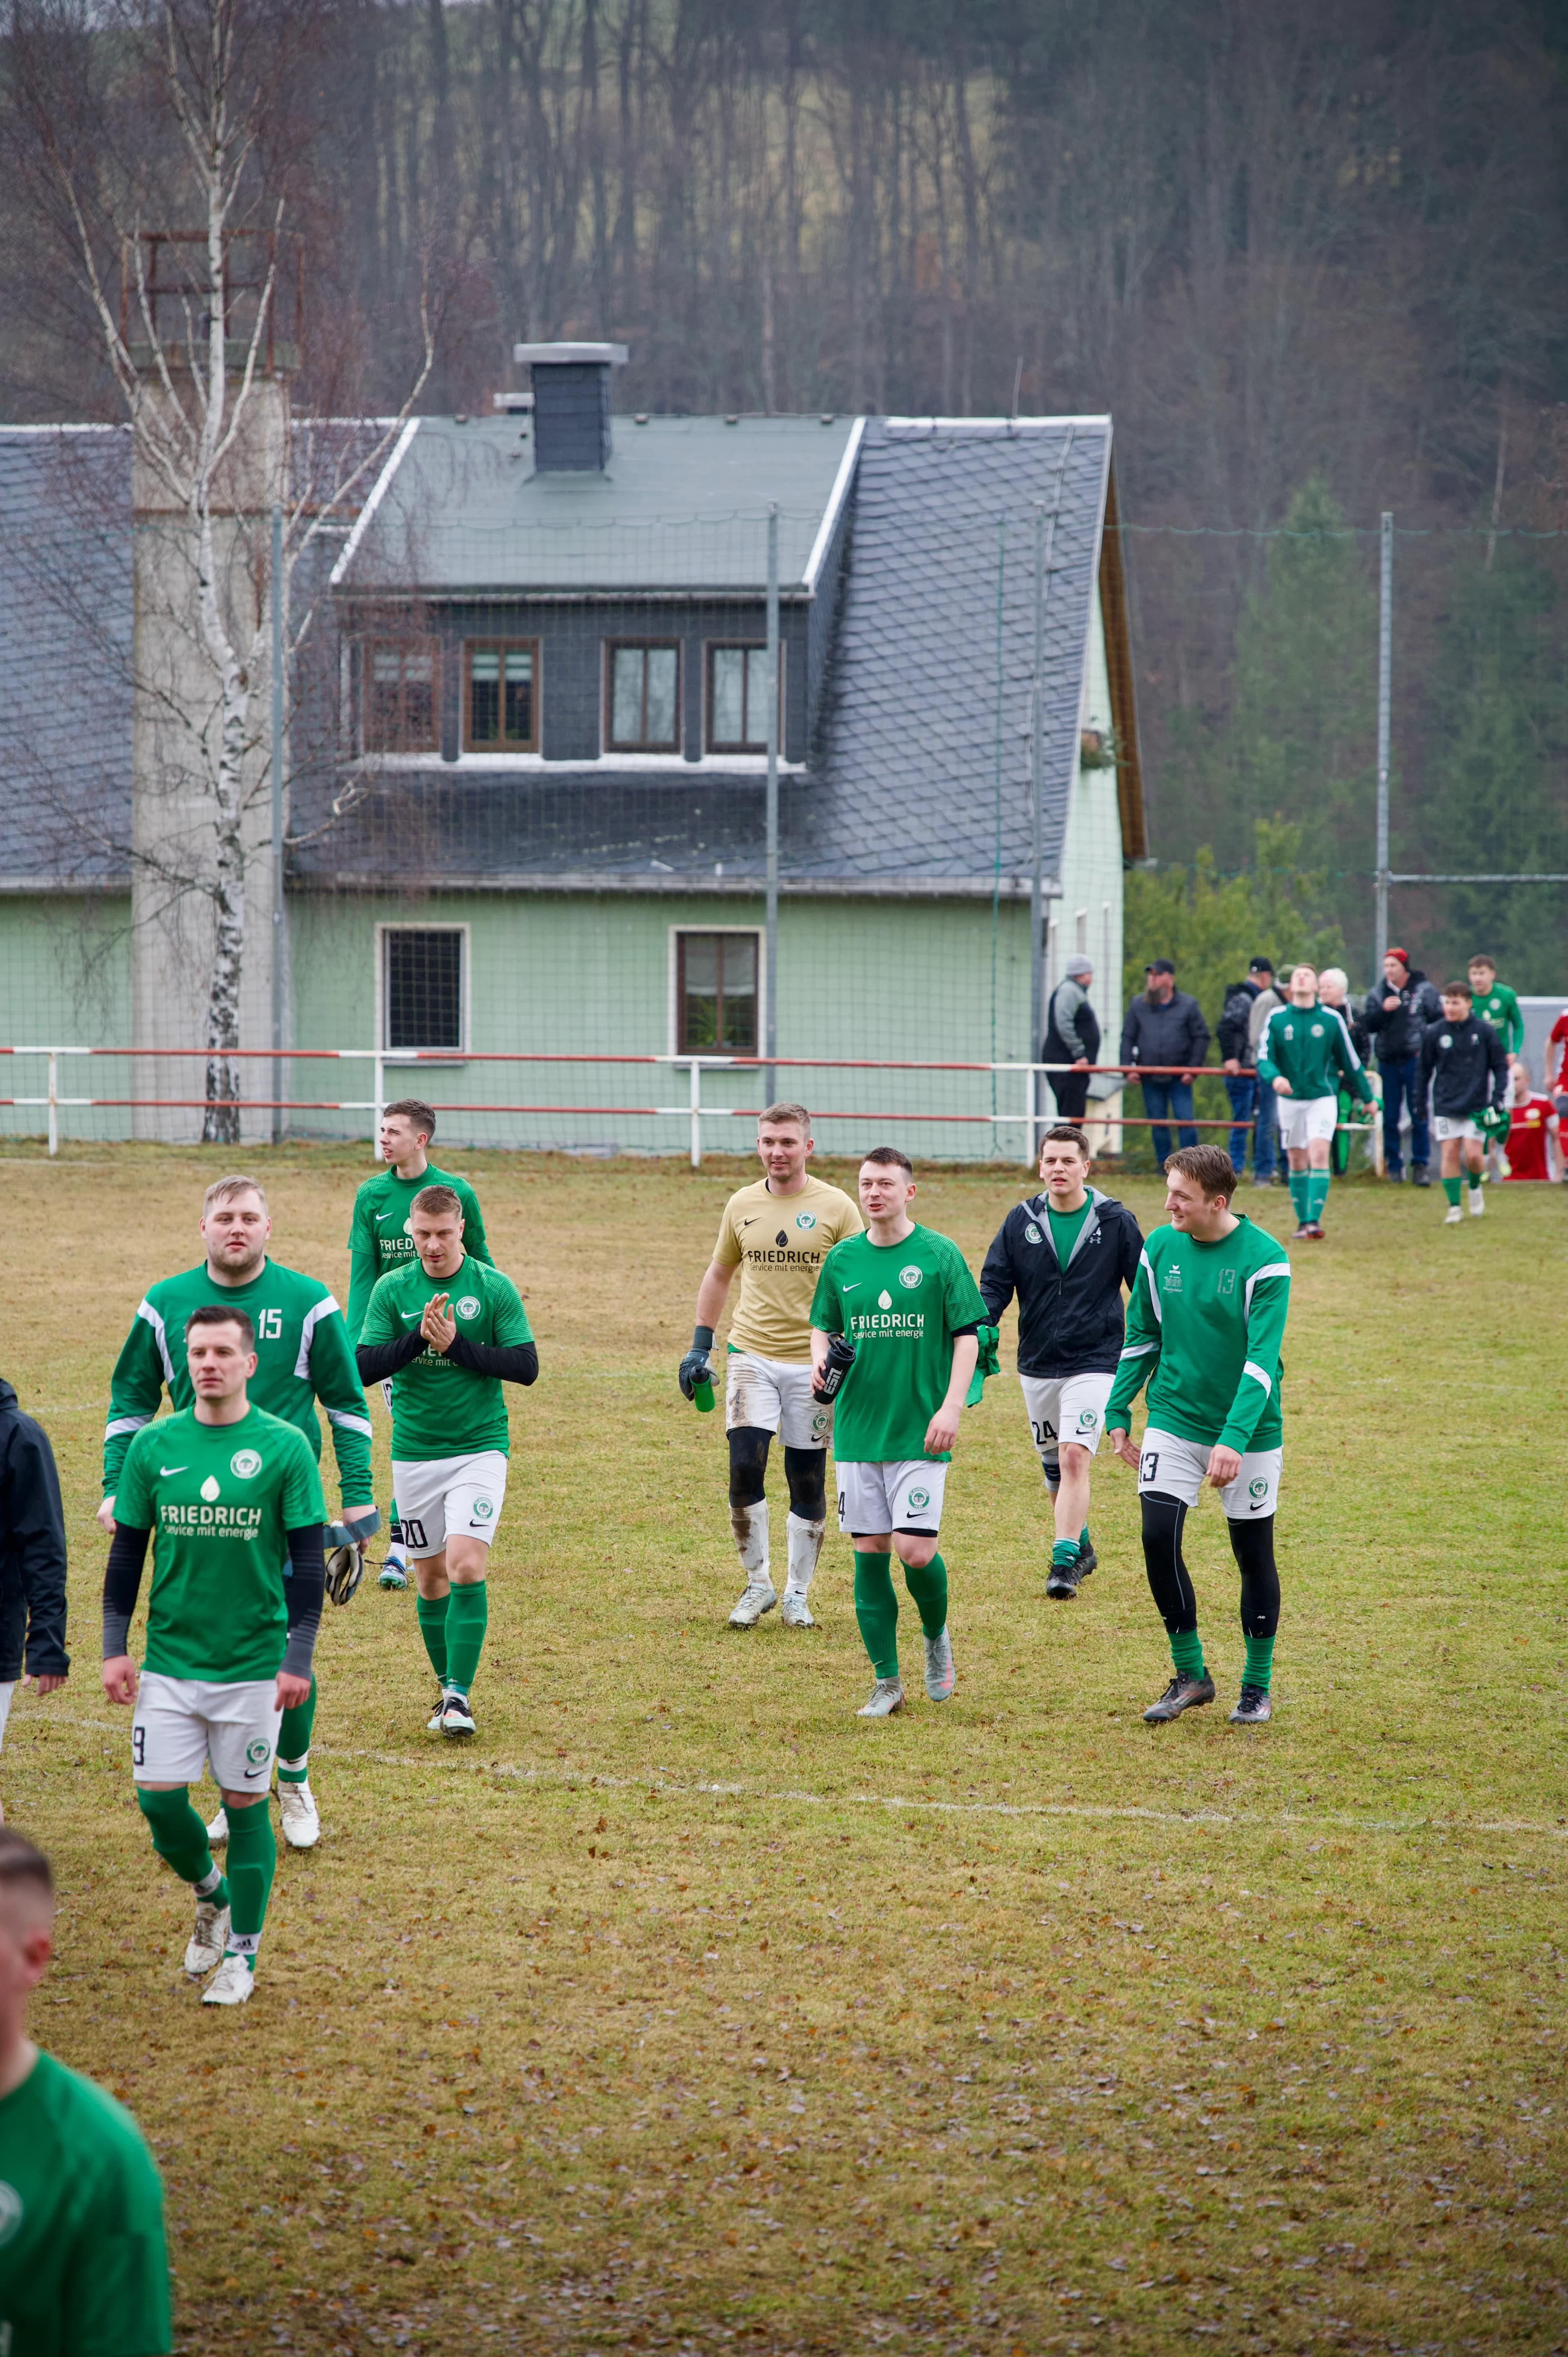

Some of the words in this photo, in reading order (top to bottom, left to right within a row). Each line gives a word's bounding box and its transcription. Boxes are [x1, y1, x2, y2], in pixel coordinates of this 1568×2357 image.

[1093, 1227, 1101, 1236] 4
[379, 1238, 414, 1251] FRIED
[748, 1251, 820, 1263] FRIEDRICH
[790, 1264, 819, 1273] energie
[1217, 1269, 1236, 1294] 13
[258, 1309, 282, 1339] 15
[851, 1313, 924, 1330] FRIEDRICH
[879, 1329, 893, 1338] mit
[895, 1329, 924, 1339] energie
[436, 1358, 451, 1366] mit
[1032, 1420, 1058, 1445] 24
[160, 1505, 262, 1526] FRIEDRICH
[838, 1492, 845, 1522] 4
[197, 1525, 216, 1536] mit
[218, 1525, 259, 1541] energie
[400, 1519, 428, 1548] 20
[134, 1726, 145, 1766] 9
